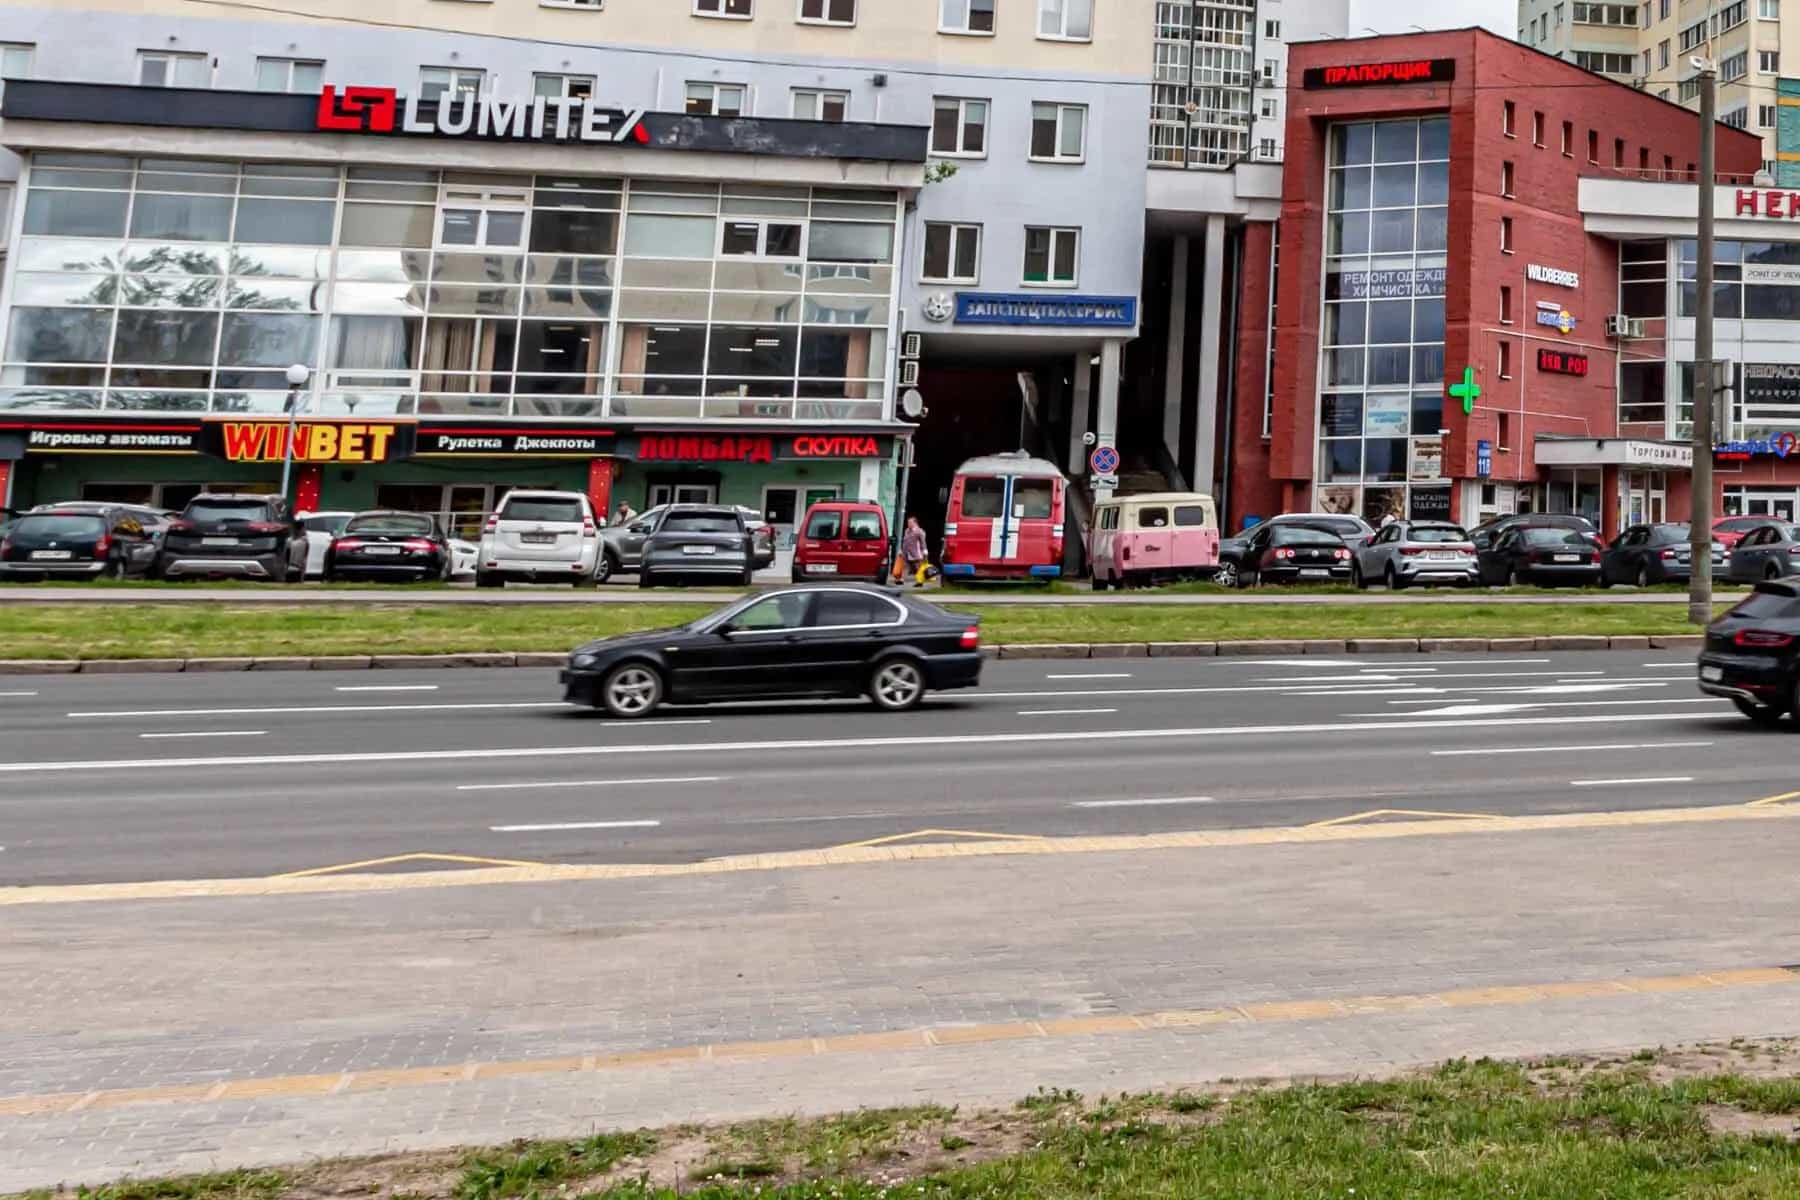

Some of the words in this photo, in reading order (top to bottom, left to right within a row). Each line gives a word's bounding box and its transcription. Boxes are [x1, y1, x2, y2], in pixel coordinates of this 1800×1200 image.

[1325, 61, 1432, 83] ПРАПОРЩИК
[403, 88, 650, 143] LUMITEX
[1344, 271, 1394, 284] РЕМОНТ
[1396, 269, 1446, 283] ОДЕЖД
[1527, 263, 1579, 288] WILDBERRIES
[1353, 284, 1431, 297] ХИМЧИСТКА
[29, 430, 105, 447] Игровые
[109, 433, 193, 446] автоматы
[223, 423, 394, 461] WINBET
[438, 435, 502, 451] Рулетка
[514, 436, 596, 451] Джекпоты
[637, 435, 773, 464] ЛОМБАРД
[792, 435, 879, 458] СКУПКА
[1633, 447, 1678, 459] ТОРГОВЫЙ
[1681, 451, 1693, 462] ДО
